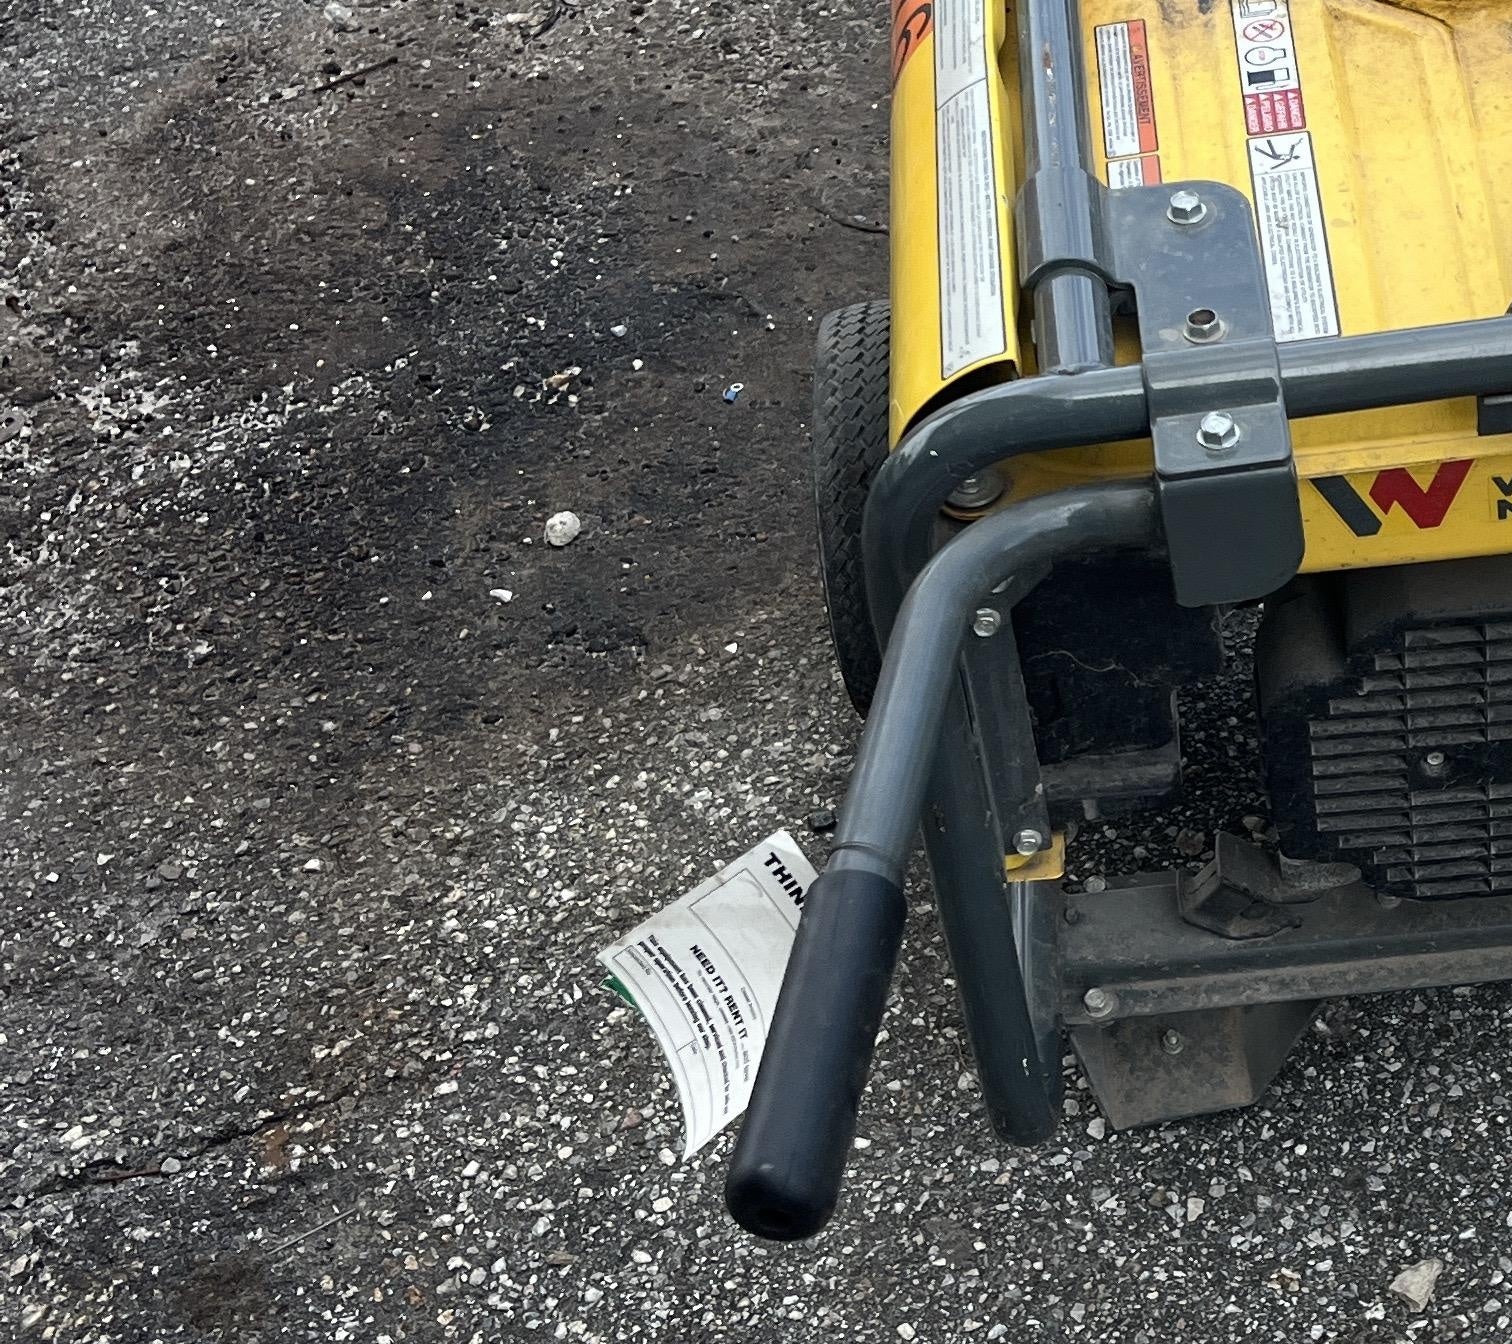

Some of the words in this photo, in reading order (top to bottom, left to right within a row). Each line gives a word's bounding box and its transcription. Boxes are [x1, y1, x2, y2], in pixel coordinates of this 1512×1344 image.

[764, 851, 806, 911] THIN
[689, 944, 716, 976] NEED
[712, 975, 729, 994] IT?
[724, 994, 745, 1027] RENT
[738, 1027, 749, 1040] IT
